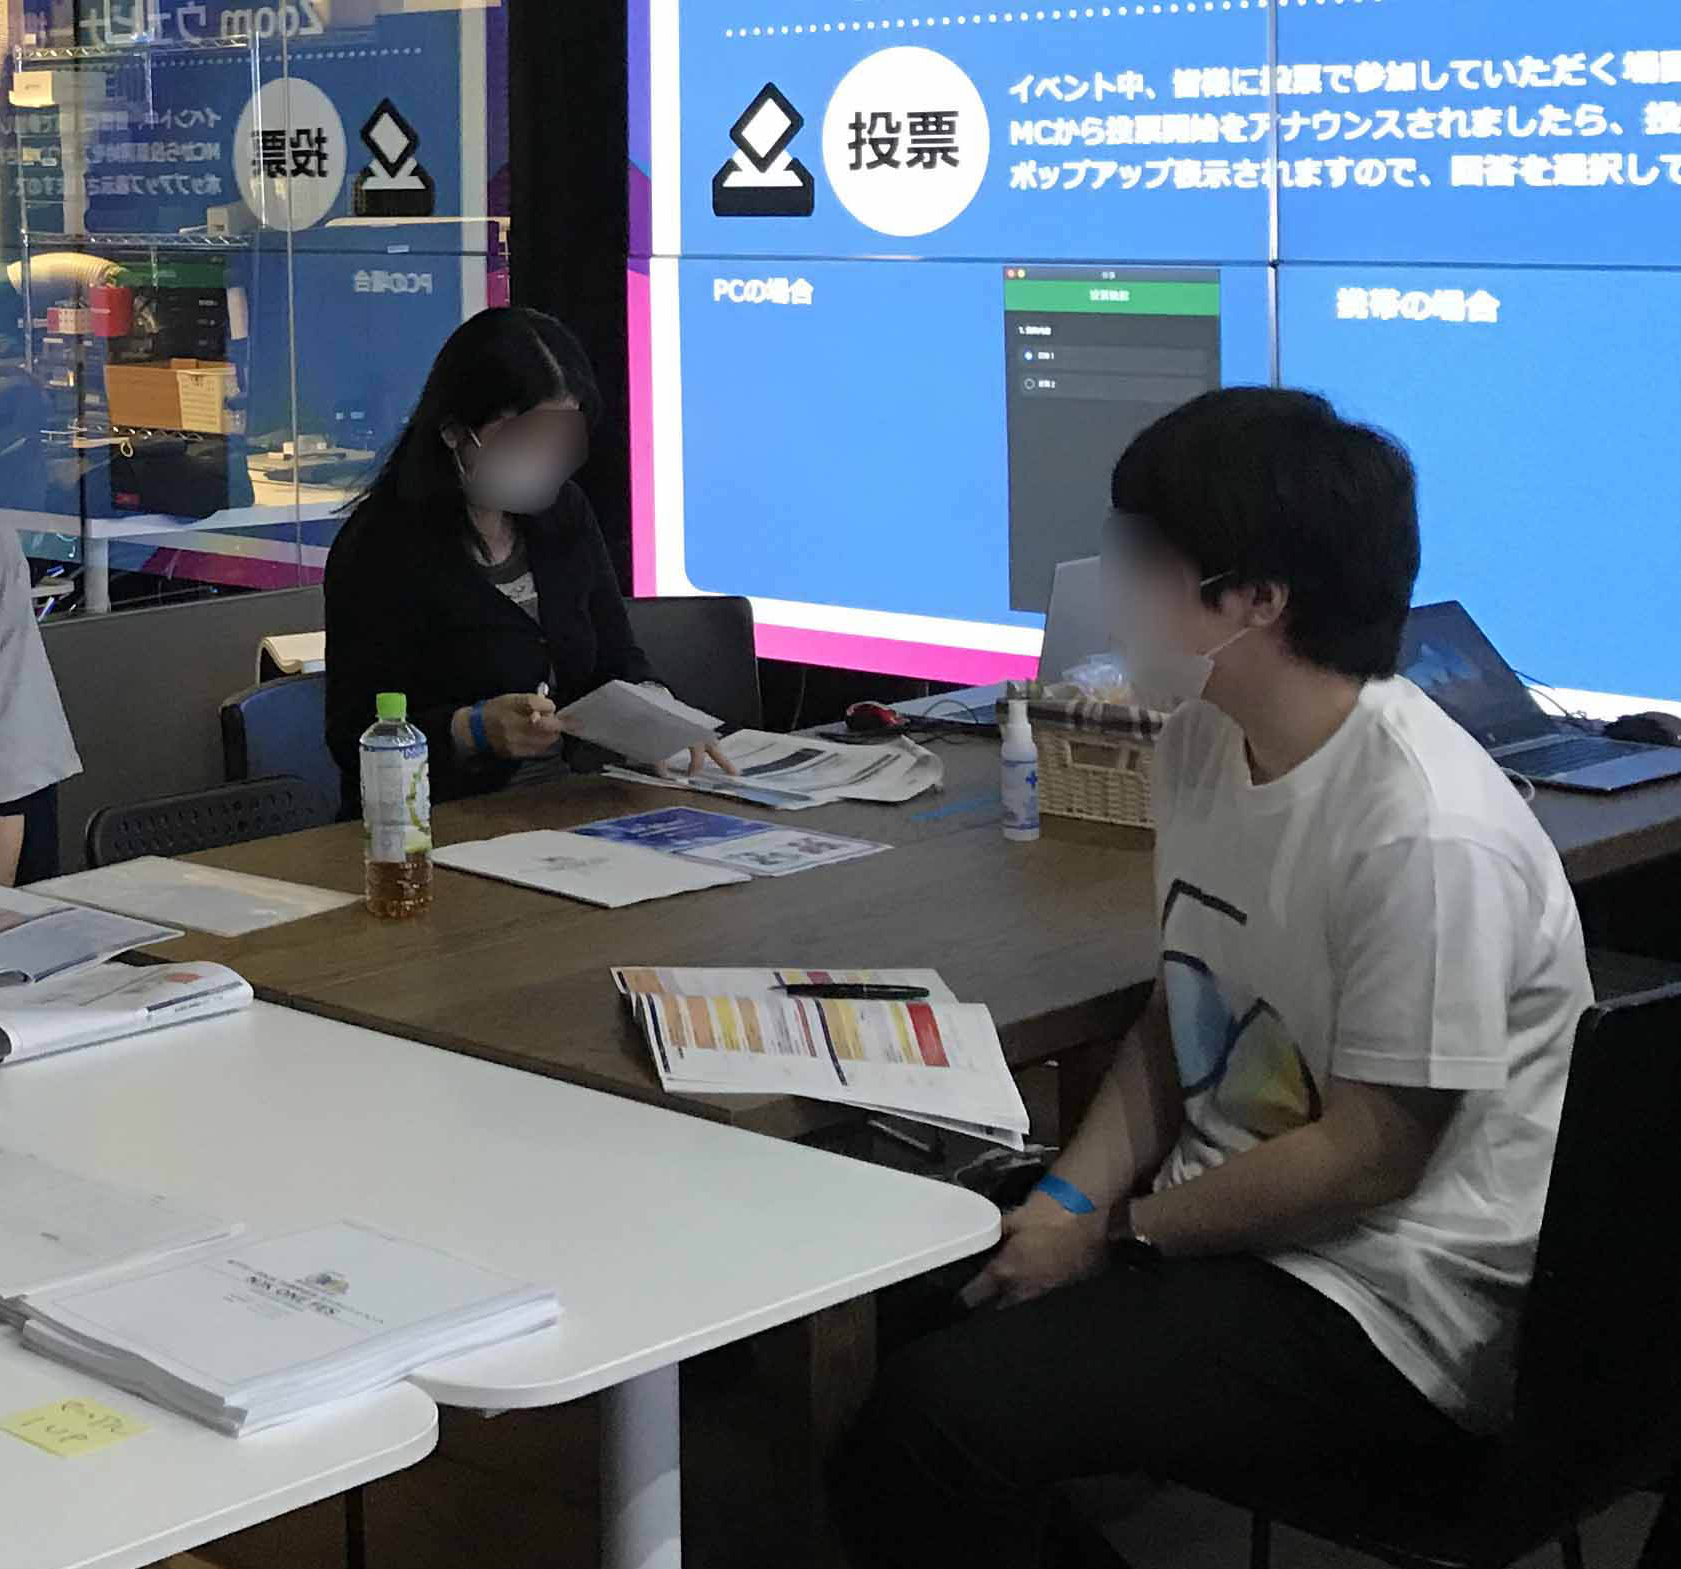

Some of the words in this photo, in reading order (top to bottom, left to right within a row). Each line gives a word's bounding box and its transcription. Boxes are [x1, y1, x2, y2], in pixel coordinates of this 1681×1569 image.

[848, 110, 960, 171] 投票
[714, 277, 814, 305] PCの場合
